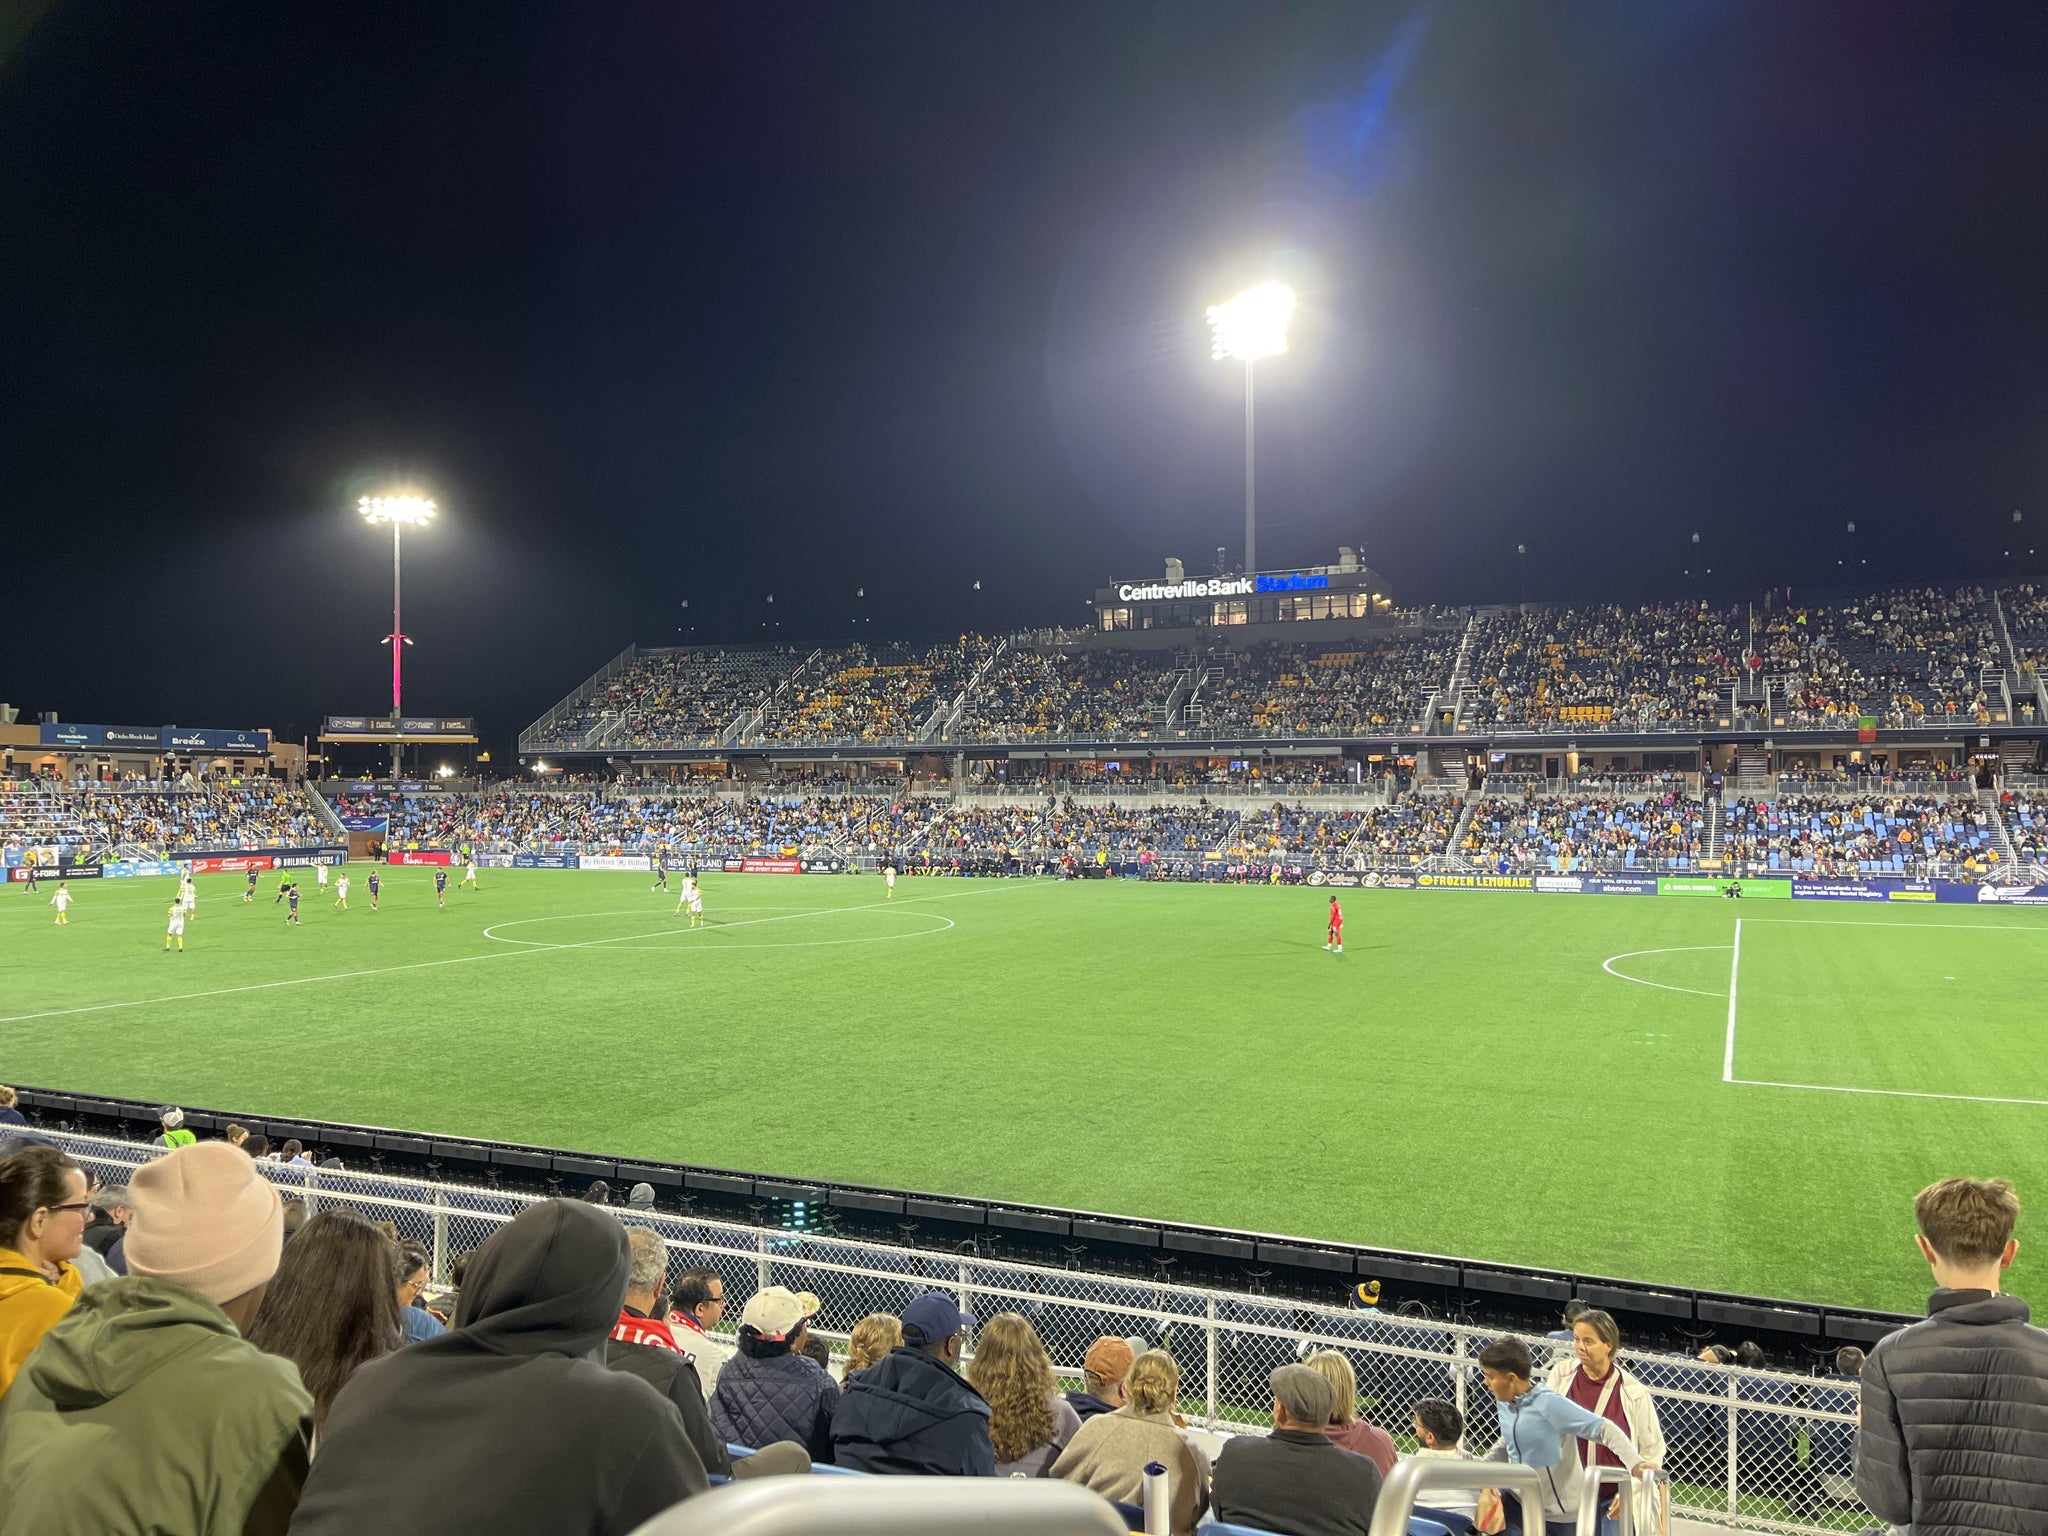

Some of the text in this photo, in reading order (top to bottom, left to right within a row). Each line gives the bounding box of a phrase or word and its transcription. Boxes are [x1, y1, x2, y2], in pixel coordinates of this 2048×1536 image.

[1256, 573, 1328, 593] Stadium
[172, 737, 206, 746] Breeze
[283, 857, 309, 867] BUILDING
[593, 858, 615, 866] Hilton
[628, 858, 650, 868] Hilton
[668, 858, 684, 867] NEW
[686, 859, 722, 868] EGLAND
[1433, 876, 1474, 887] FROZEN
[1476, 876, 1532, 888] LEMONADE
